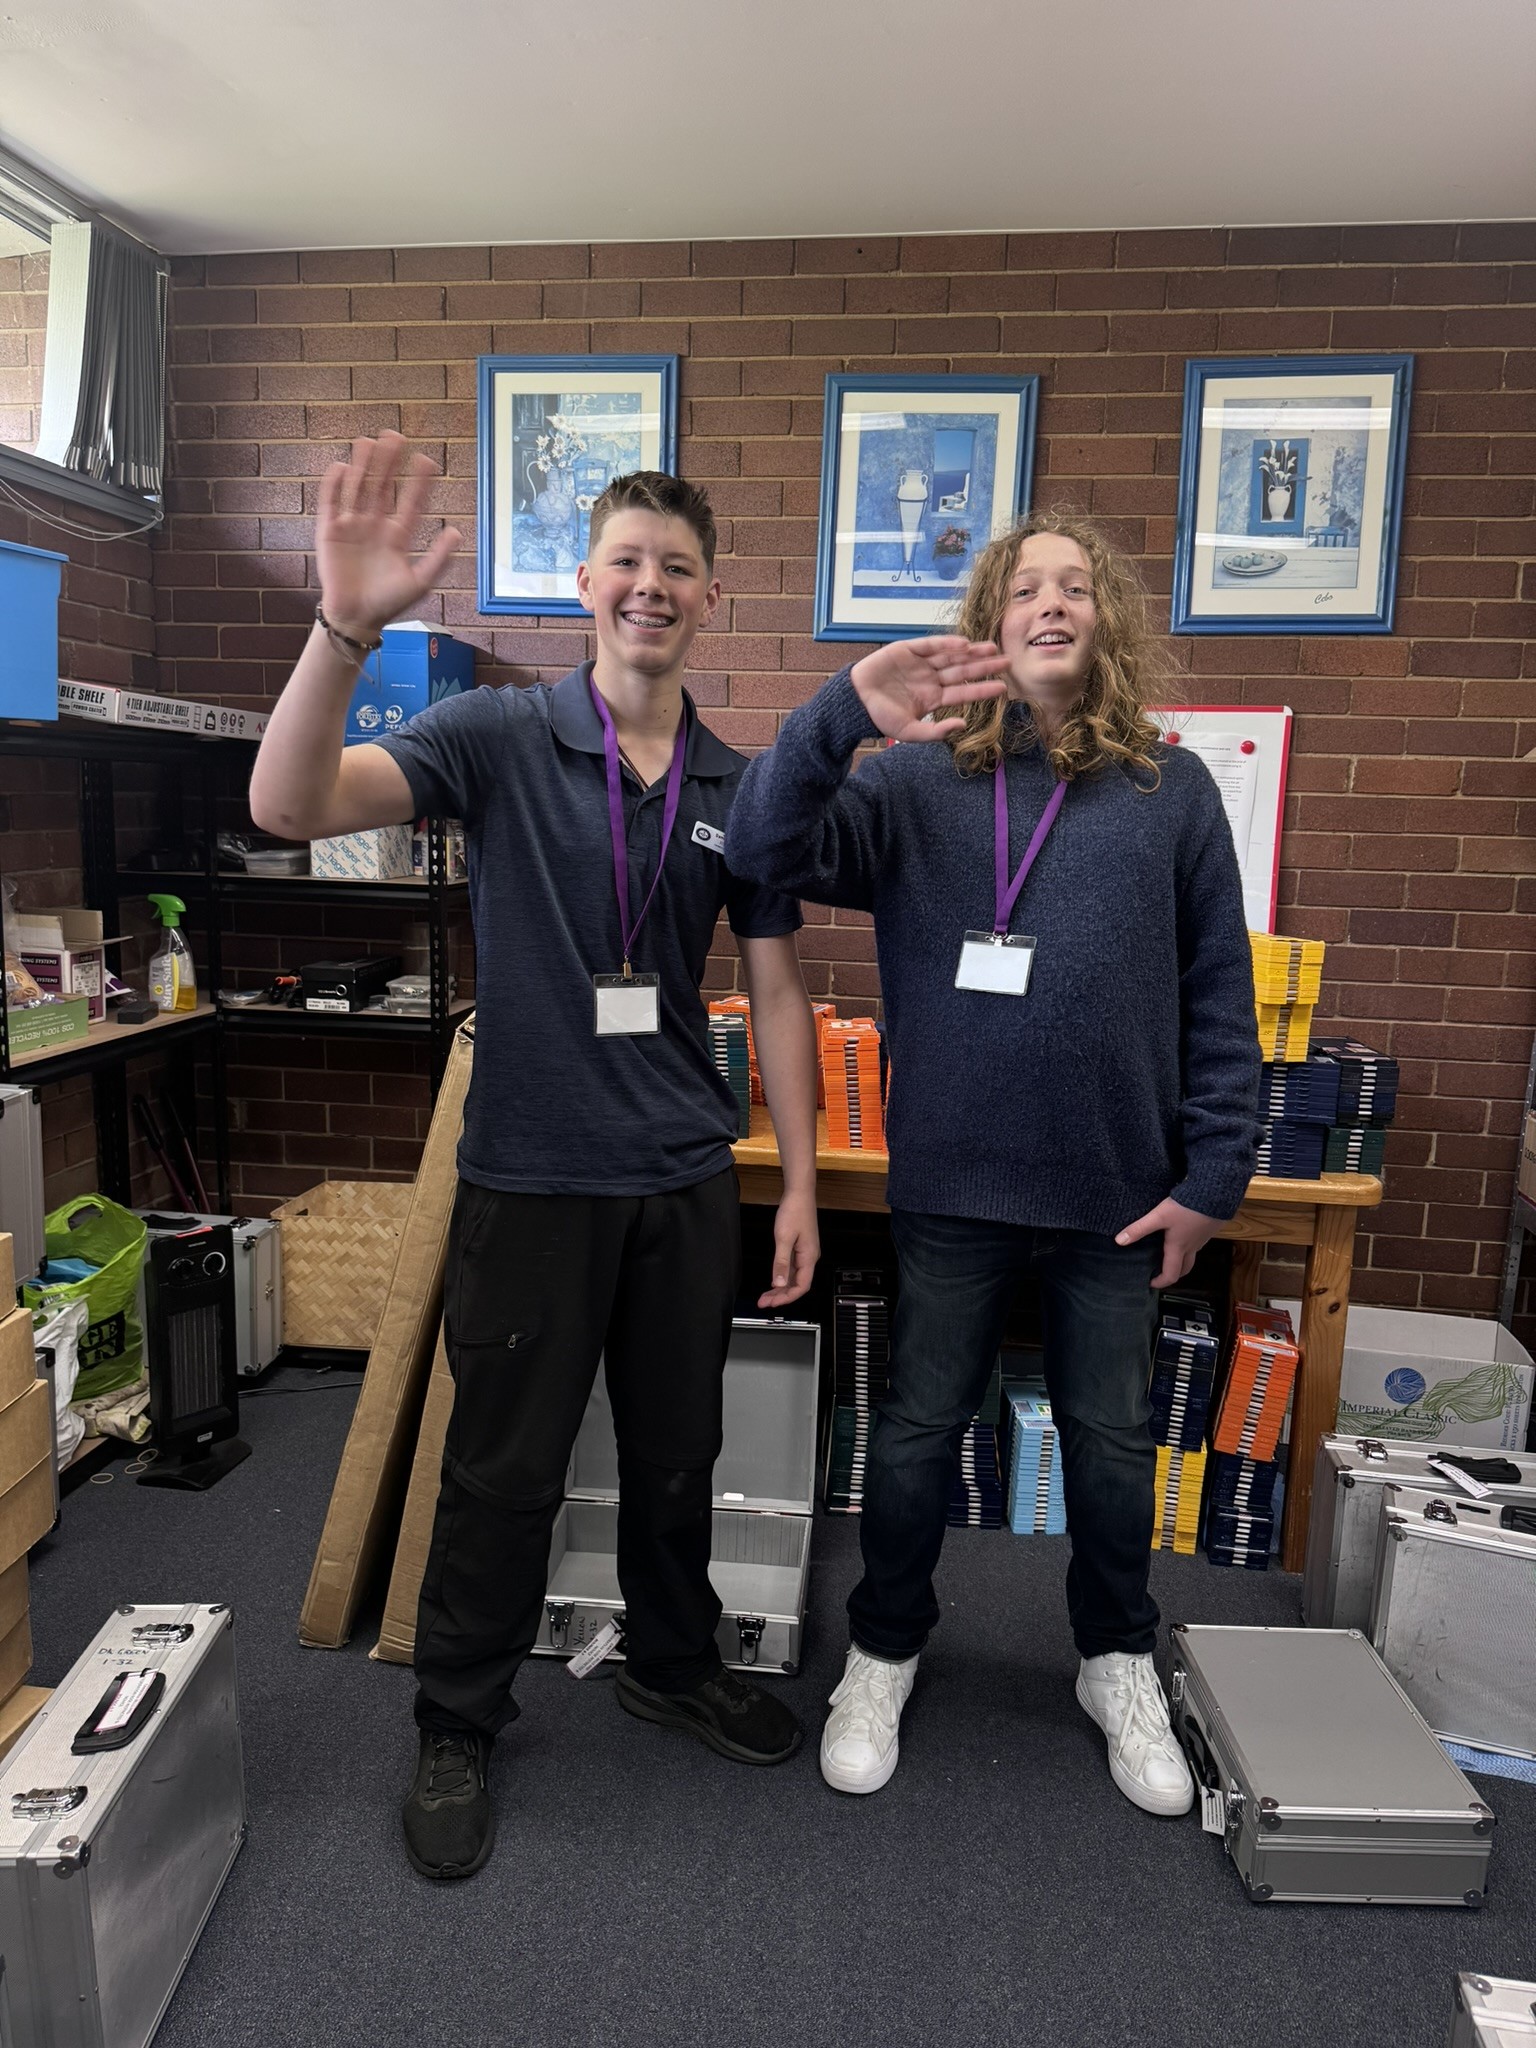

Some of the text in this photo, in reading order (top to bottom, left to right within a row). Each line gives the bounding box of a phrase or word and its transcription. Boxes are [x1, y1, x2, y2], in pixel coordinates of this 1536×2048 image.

[78, 688, 105, 704] SHELF
[126, 698, 131, 710] 4
[131, 698, 142, 710] TIER
[143, 700, 174, 714] ADJUSTABLE
[338, 840, 361, 863] hager
[327, 852, 350, 876] hager
[62, 1023, 75, 1033] COS
[1341, 1400, 1400, 1417] IMPERIAL
[1403, 1408, 1457, 1425] CLASSIC
